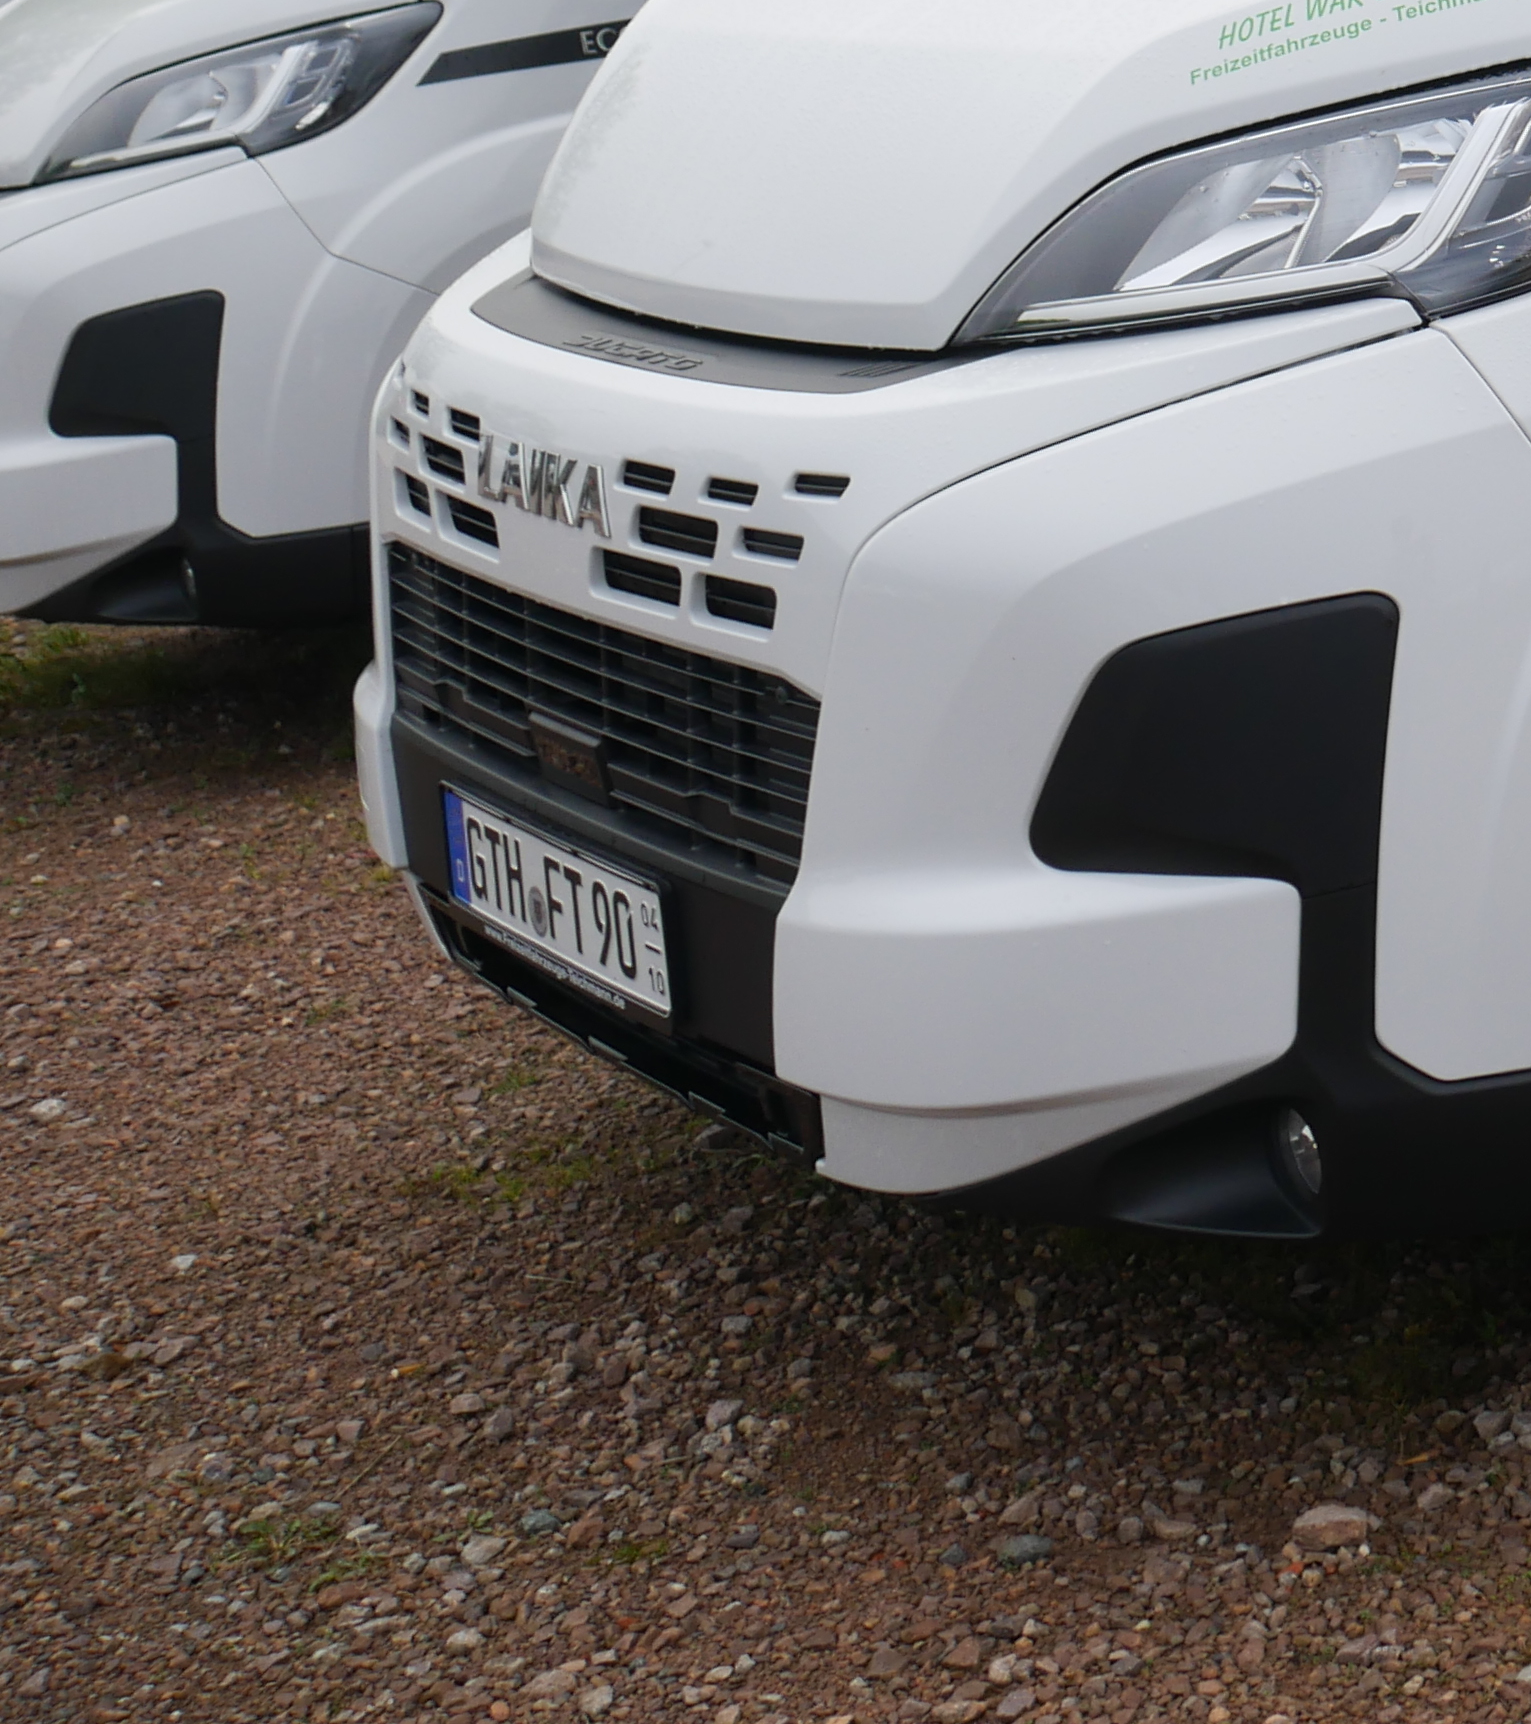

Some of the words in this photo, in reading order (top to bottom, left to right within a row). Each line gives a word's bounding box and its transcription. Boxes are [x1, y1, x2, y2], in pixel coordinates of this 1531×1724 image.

[579, 26, 626, 56] EC
[1189, 15, 1373, 86] Freizeitfahrzeuge
[1217, 3, 1295, 50] HOTEL
[476, 433, 611, 539] LAIKA
[466, 815, 527, 923] GTH
[543, 854, 584, 955] FT
[592, 879, 638, 980] 90
[647, 966, 666, 996] 10
